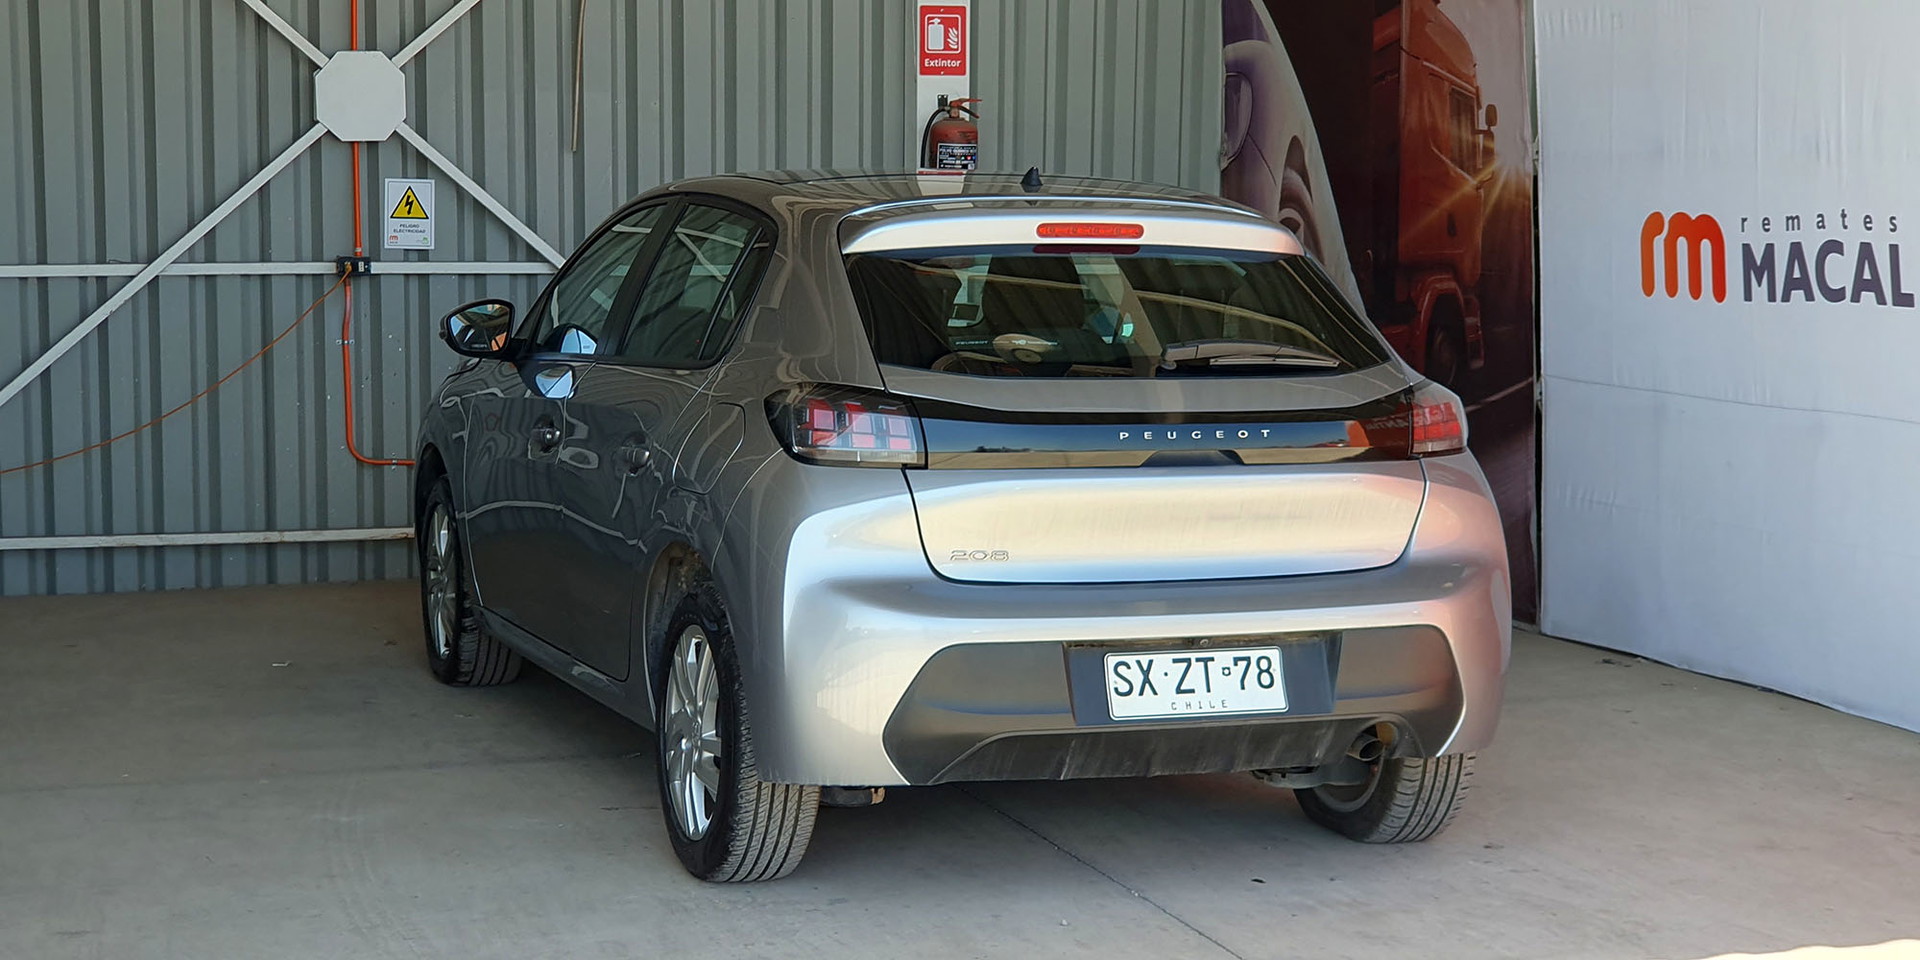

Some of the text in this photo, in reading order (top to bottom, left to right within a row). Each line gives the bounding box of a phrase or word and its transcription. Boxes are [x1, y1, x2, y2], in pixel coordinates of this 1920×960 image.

[924, 58, 961, 67] Extintor
[1740, 208, 1898, 233] remates
[1741, 239, 1915, 308] MACAL
[1119, 429, 1271, 440] PEUGEOT
[950, 550, 1010, 562] 208
[1170, 699, 1229, 711] CHILE
